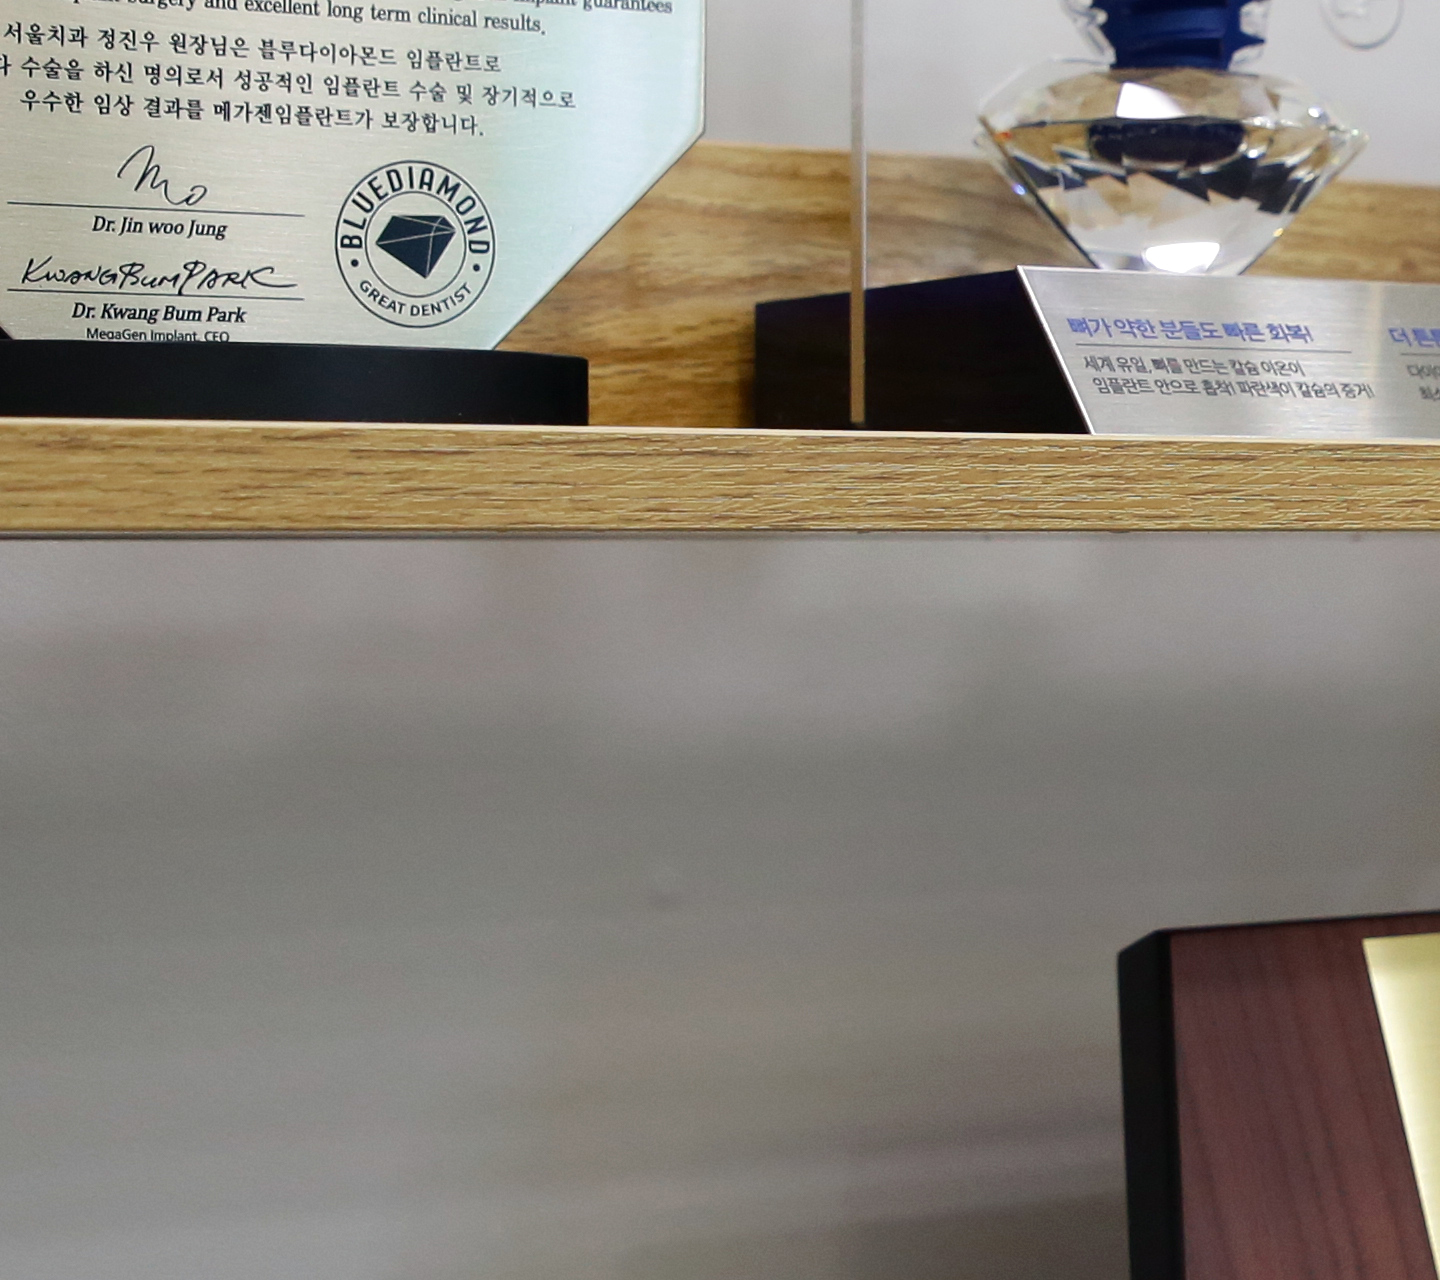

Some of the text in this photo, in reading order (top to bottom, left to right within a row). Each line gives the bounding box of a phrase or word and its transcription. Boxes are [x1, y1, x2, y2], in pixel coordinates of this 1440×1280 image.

[327, 0, 364, 23] long
[370, 4, 411, 23] term
[417, 6, 477, 28] clinical
[483, 13, 546, 36] results.
[4, 21, 501, 72] 서울치과 정진우 원장님은 블루다이아몬드 임플란트로
[20, 89, 484, 136] 우수한 임상 결과를 메가젠임플란트가 보장합니다.
[339, 165, 491, 255] BLUEDIAMOND
[358, 279, 474, 317] GREAT DENTIST
